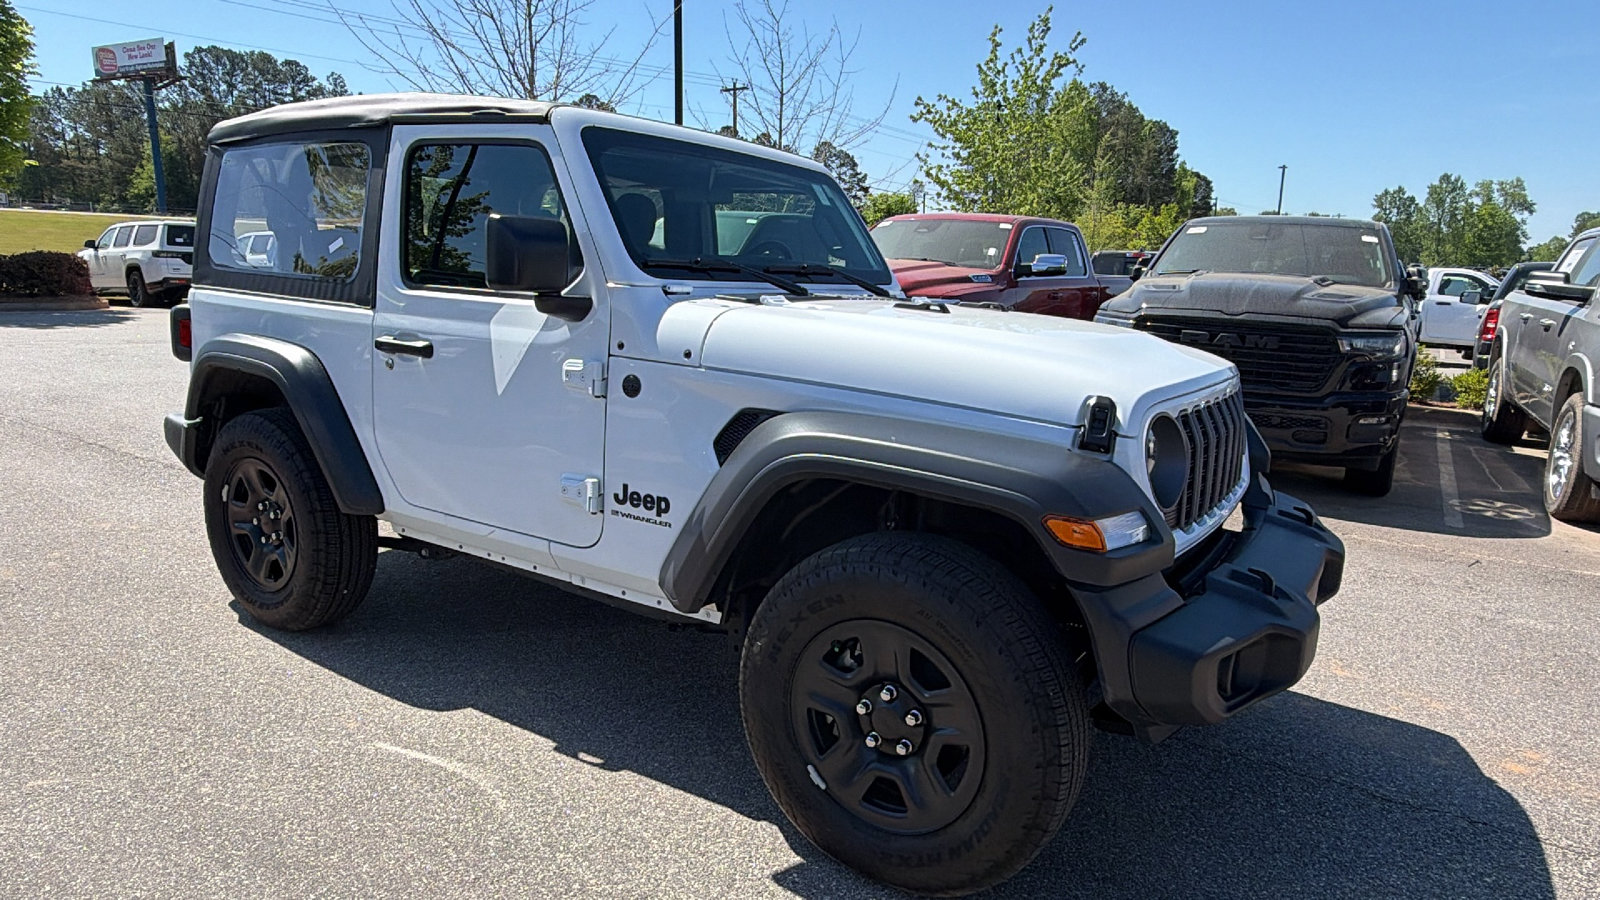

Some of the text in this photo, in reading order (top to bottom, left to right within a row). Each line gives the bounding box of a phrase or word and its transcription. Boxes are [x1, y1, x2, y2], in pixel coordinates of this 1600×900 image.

[122, 46, 136, 54] Come
[1181, 329, 1280, 349] RAM
[613, 483, 671, 517] Jeep
[620, 511, 673, 529] WRANGLER
[768, 594, 845, 663] NEXEN
